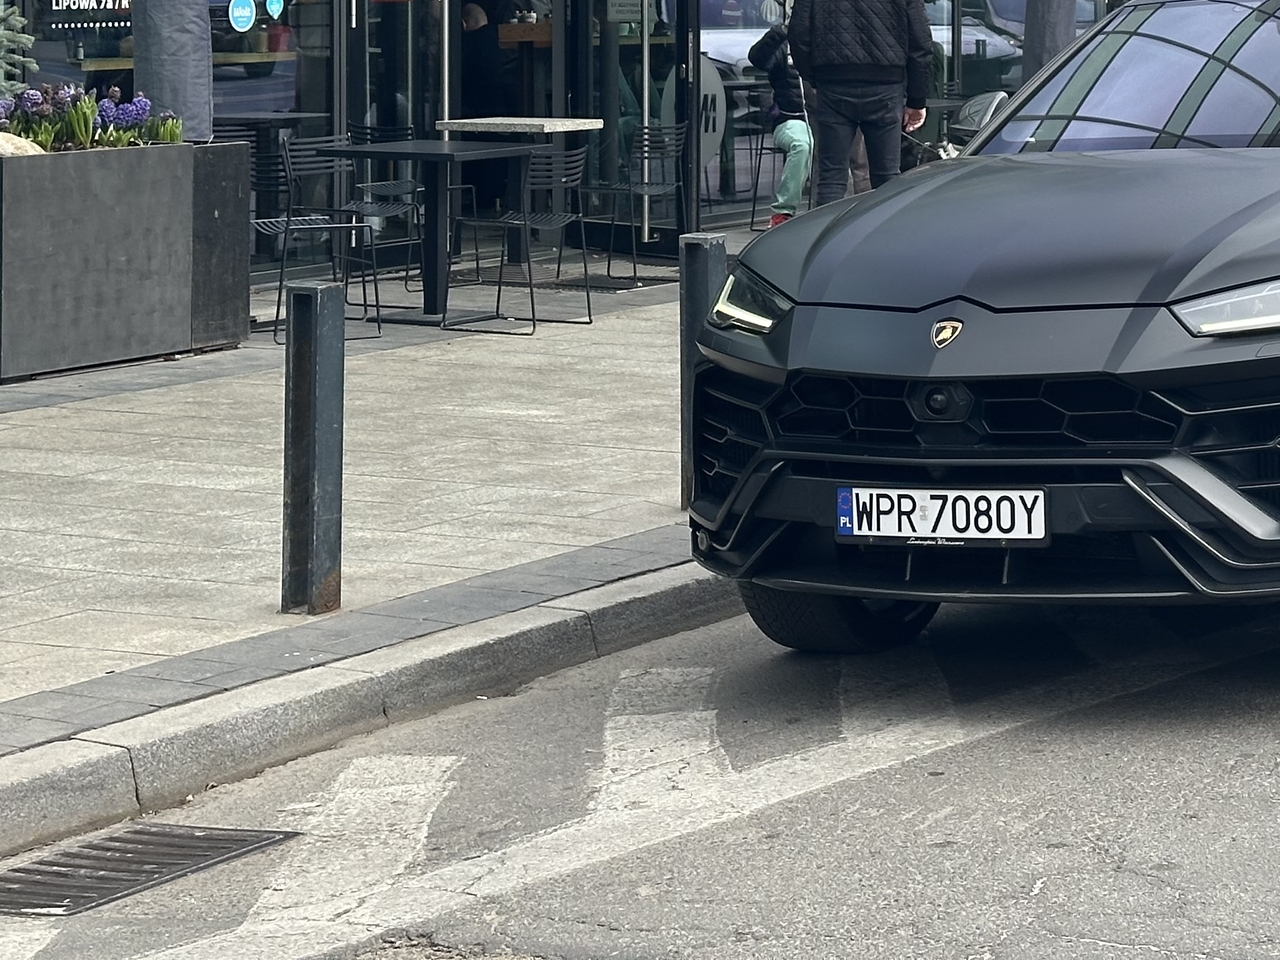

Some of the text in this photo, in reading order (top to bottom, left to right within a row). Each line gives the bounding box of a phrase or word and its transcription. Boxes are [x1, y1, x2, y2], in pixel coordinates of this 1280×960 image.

[840, 516, 852, 528] PL
[855, 492, 1040, 534] WPR 7080Y
